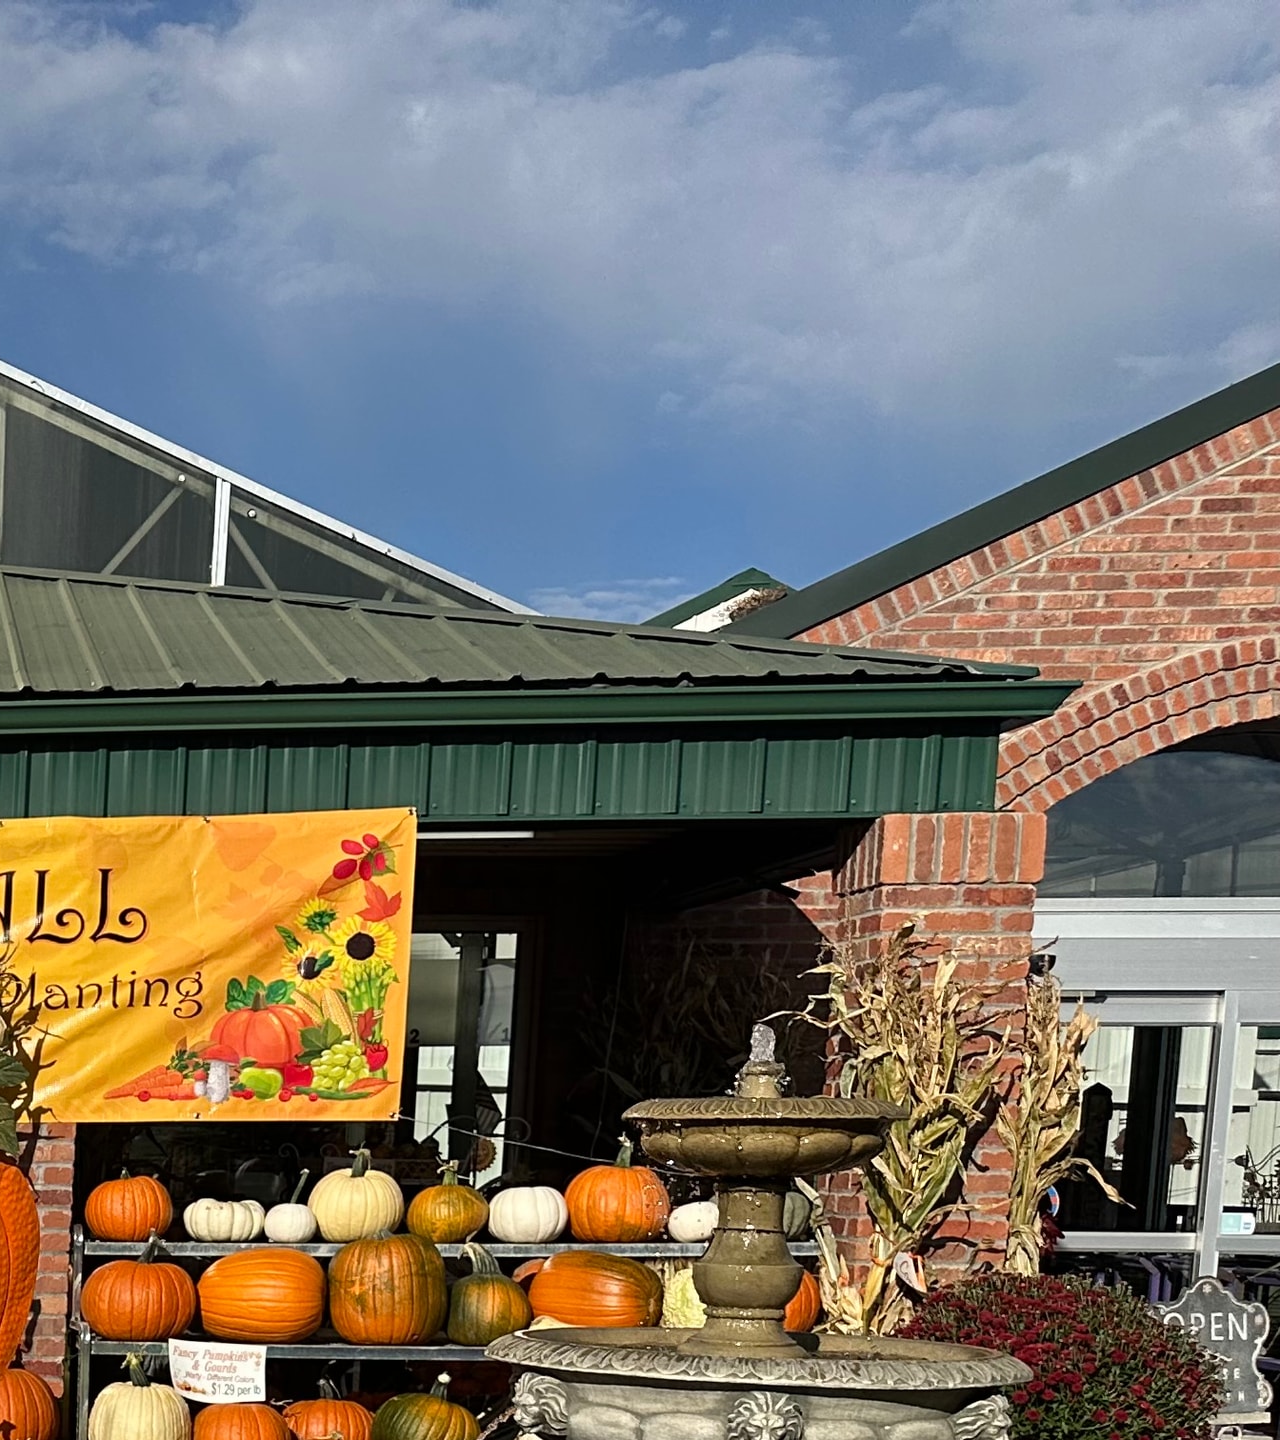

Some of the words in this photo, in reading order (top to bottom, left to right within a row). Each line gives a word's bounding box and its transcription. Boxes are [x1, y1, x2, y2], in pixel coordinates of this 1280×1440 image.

[172, 1345, 199, 1360] Fancy
[202, 1349, 248, 1362] Pumpkins
[191, 1360, 200, 1371] &
[204, 1361, 237, 1373] Gourds
[206, 1373, 234, 1383] Different
[211, 1382, 235, 1396] $1.29
[237, 1386, 251, 1397] per
[254, 1384, 261, 1395] lb
